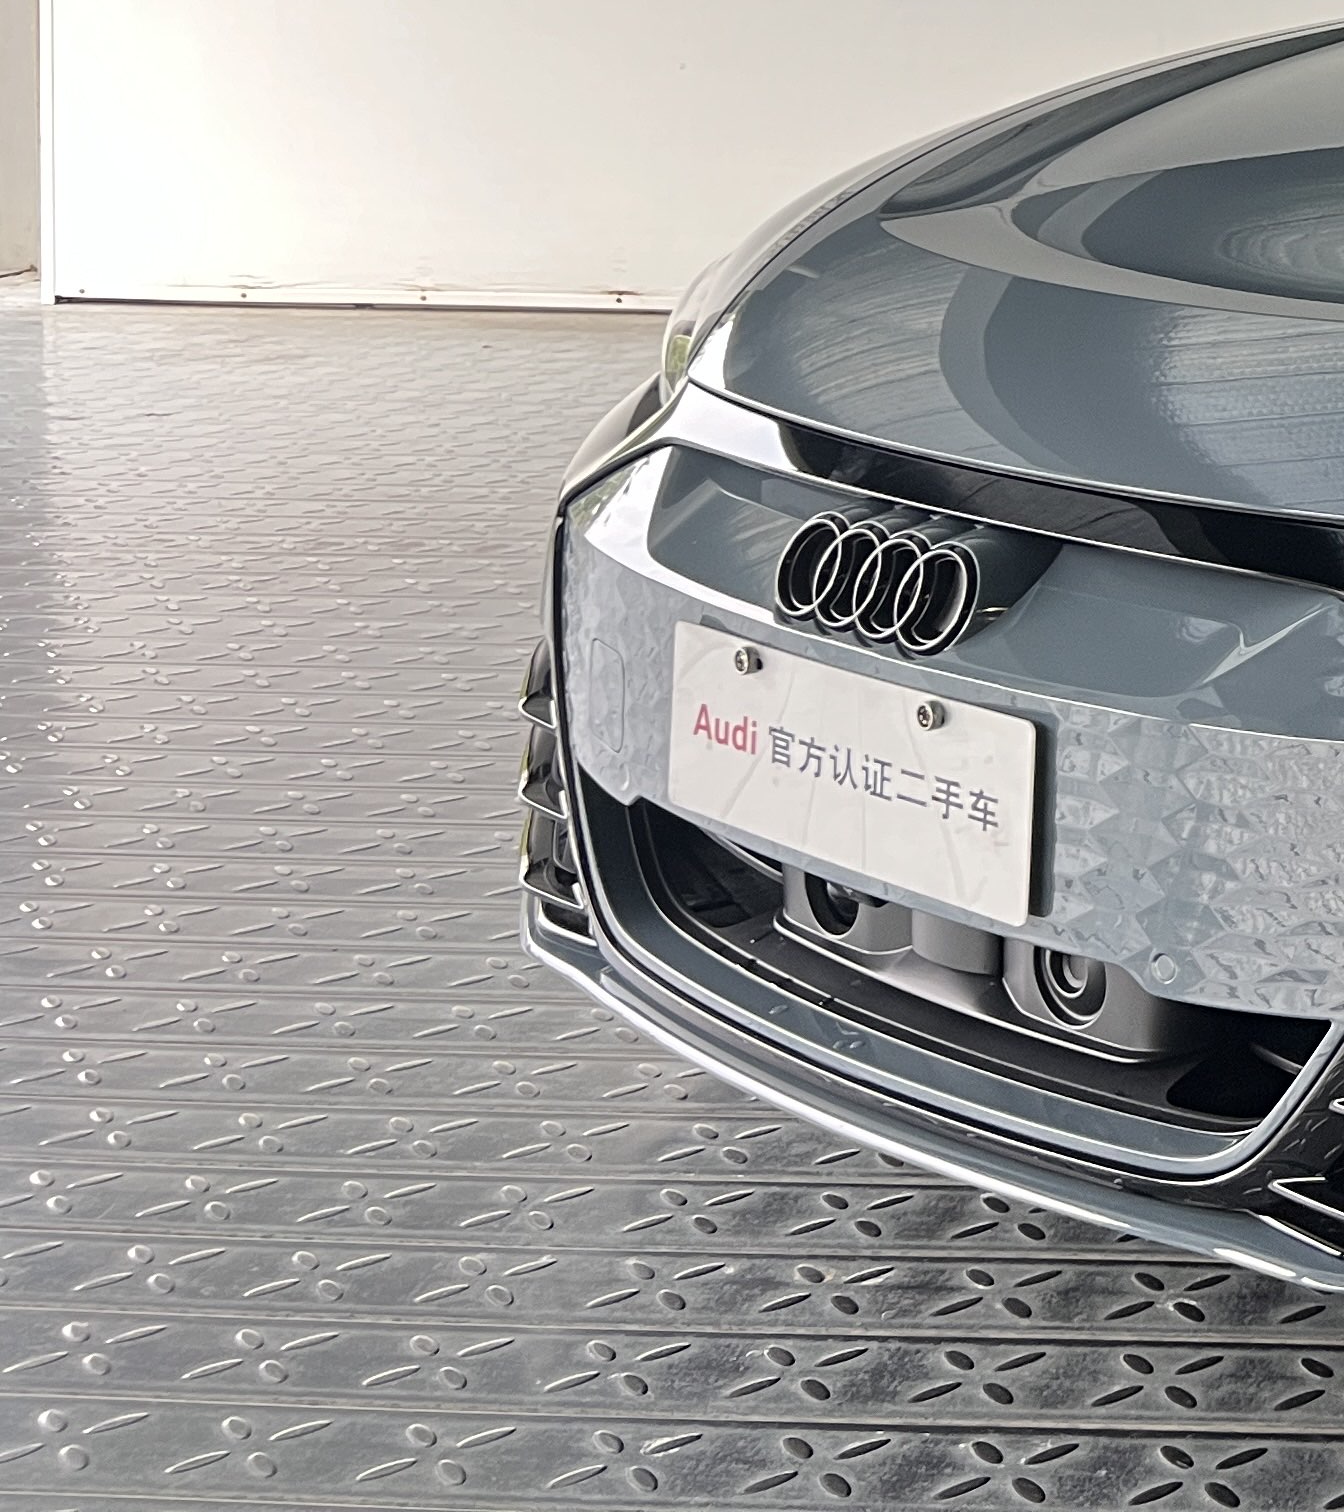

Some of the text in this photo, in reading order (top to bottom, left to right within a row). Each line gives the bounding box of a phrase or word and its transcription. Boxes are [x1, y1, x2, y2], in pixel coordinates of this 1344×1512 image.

[693, 703, 999, 832] Audi 官方认证二手车
